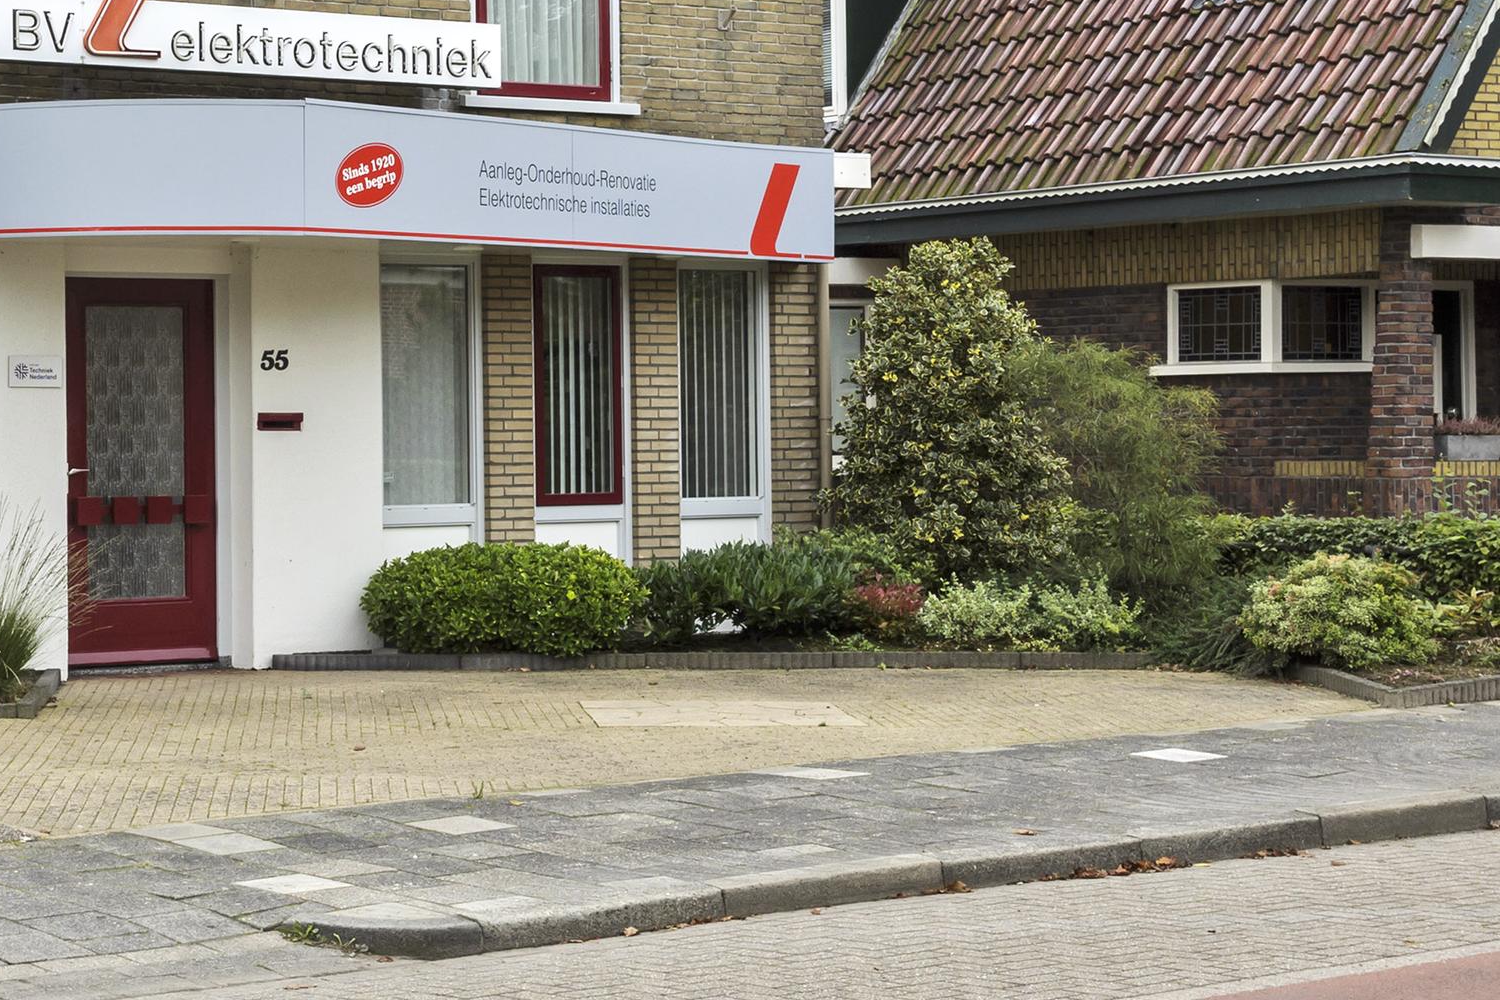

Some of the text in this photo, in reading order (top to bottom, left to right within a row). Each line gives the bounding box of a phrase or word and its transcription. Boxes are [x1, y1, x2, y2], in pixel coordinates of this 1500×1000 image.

[12, 8, 75, 53] BV
[170, 21, 493, 79] elektrotechniek
[342, 153, 395, 181] Sinds 1920
[478, 159, 657, 192] Aanleg-Onderhoud-Renovatie
[346, 170, 397, 196] een begrip
[479, 187, 651, 218] Elektrotechnische installaties
[260, 349, 290, 371] 55
